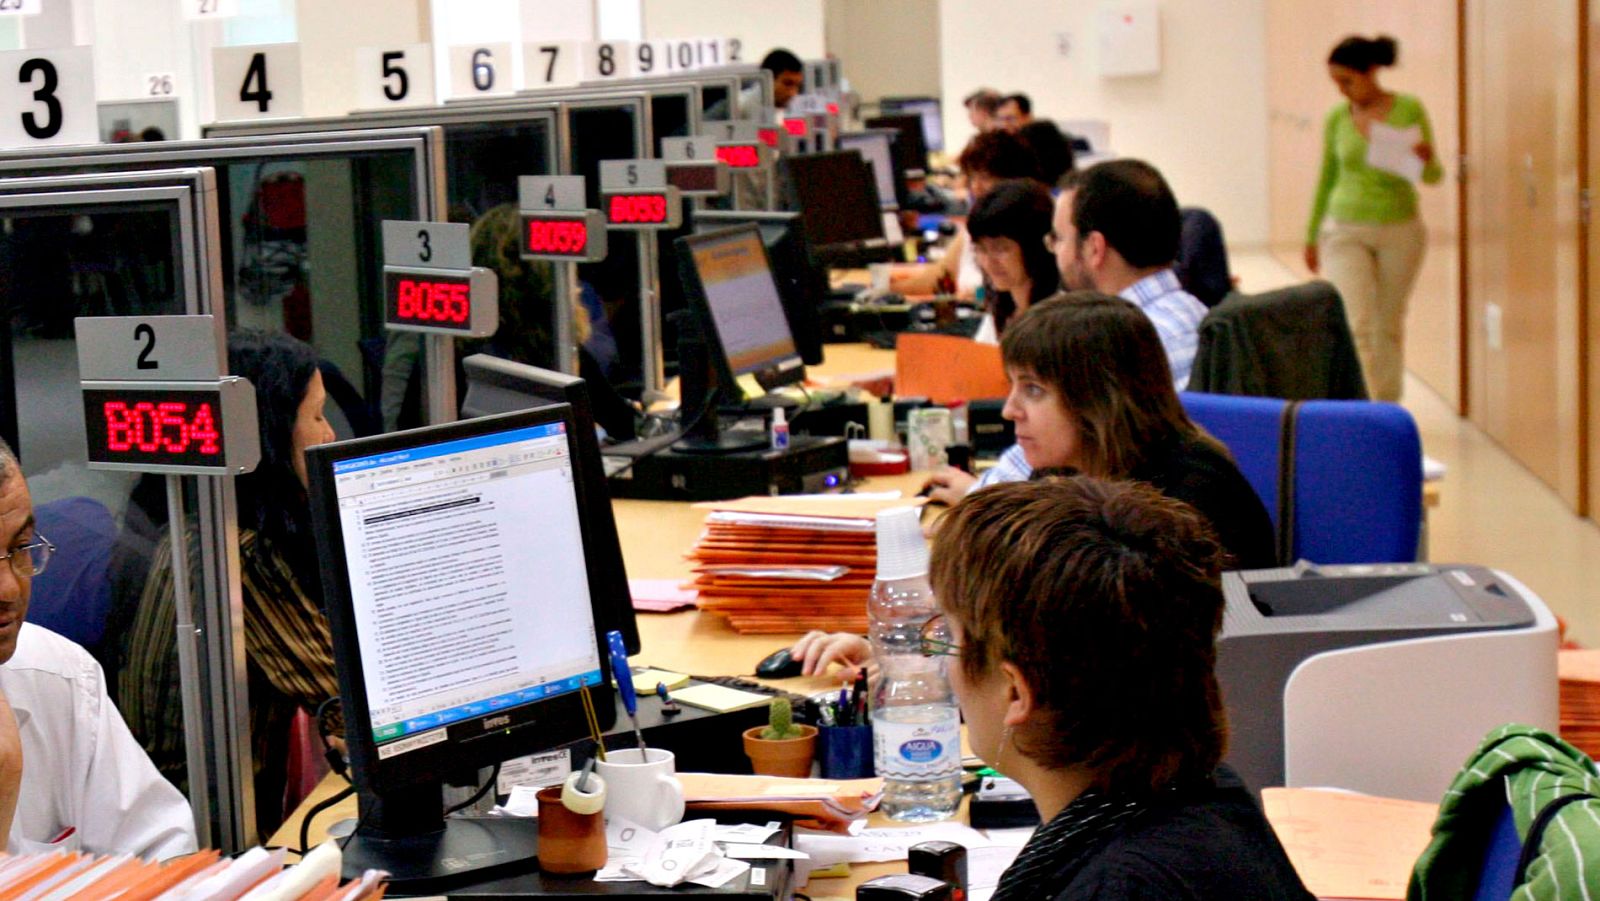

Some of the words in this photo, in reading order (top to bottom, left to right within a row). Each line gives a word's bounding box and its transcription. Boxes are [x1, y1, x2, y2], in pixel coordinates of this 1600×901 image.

[382, 51, 409, 101] 5
[472, 48, 495, 91] 6
[540, 46, 559, 82] 7
[598, 44, 615, 76] 8
[638, 44, 653, 72] 9
[18, 57, 63, 140] 3
[149, 76, 173, 96] 26
[239, 52, 273, 113] 4
[685, 142, 694, 159] 6
[627, 164, 638, 185] 5
[544, 184, 556, 208] 4
[417, 229, 432, 263] 3
[397, 279, 470, 323] B055
[133, 323, 159, 370] 2
[103, 401, 220, 455] B054
